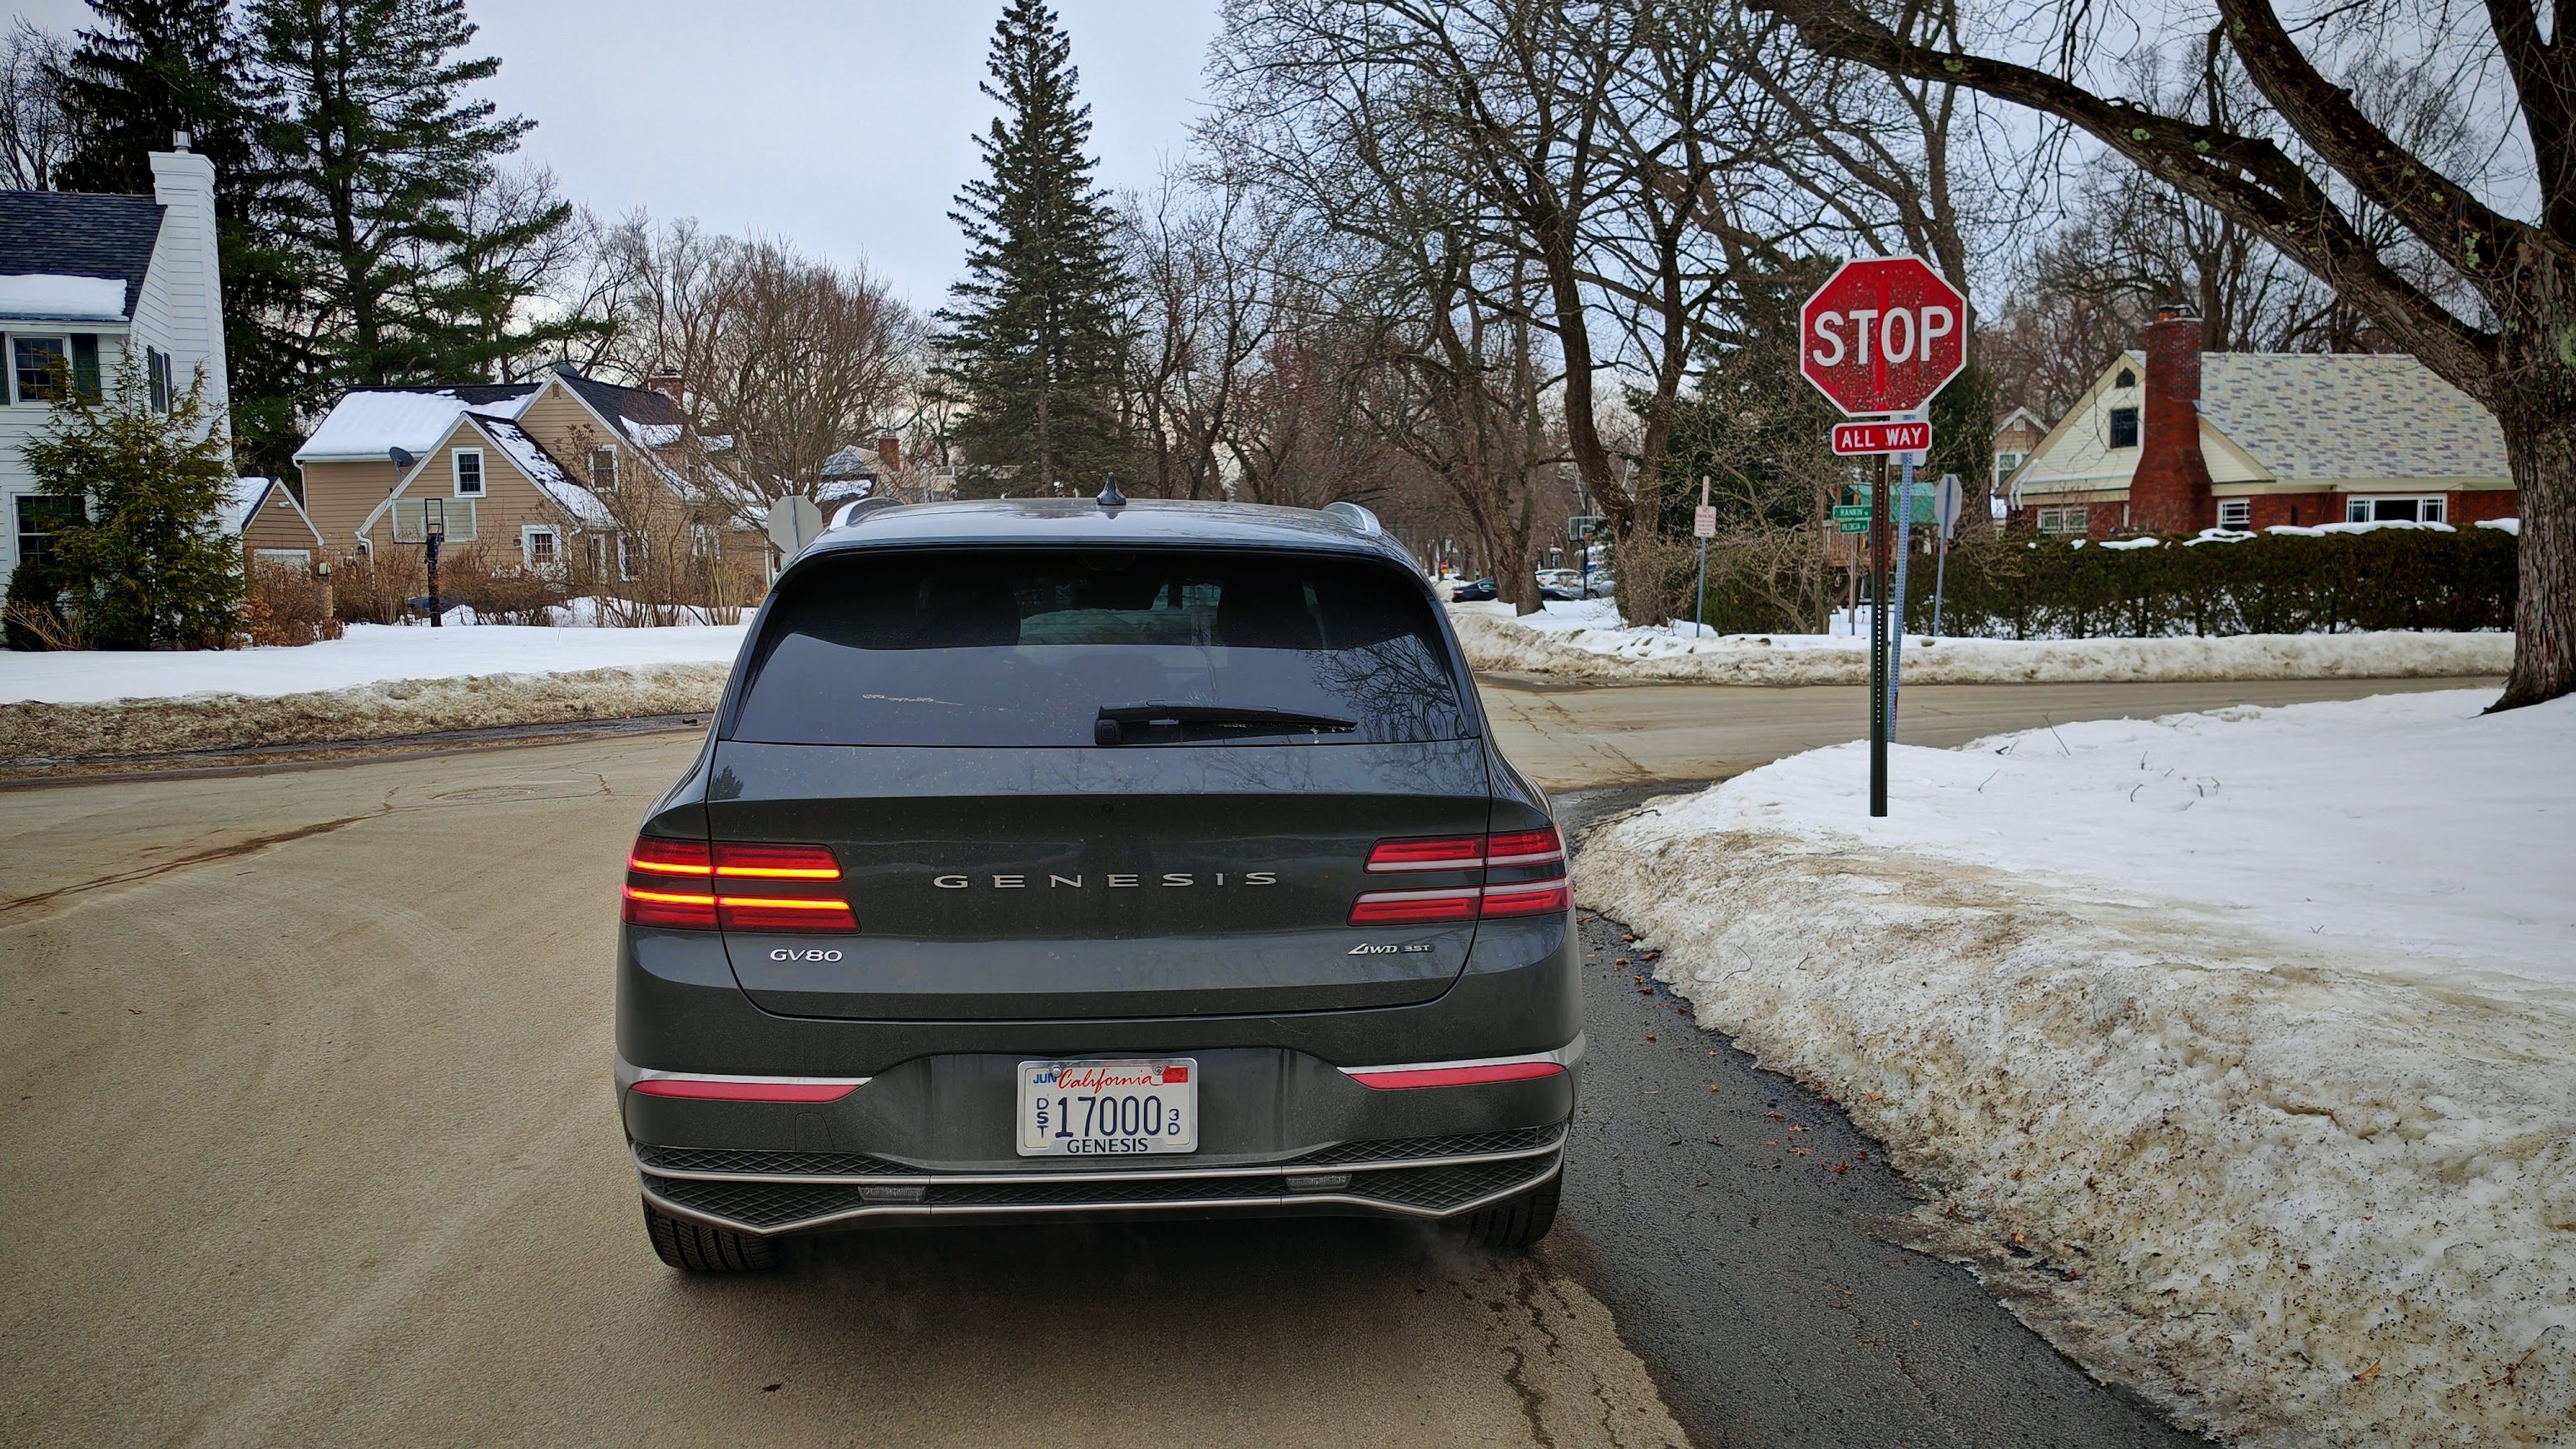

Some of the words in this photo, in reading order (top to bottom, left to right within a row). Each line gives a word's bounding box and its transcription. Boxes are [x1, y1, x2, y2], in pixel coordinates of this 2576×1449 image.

[1812, 305, 1954, 367] STOP
[1840, 429, 1875, 448] ALL
[1885, 427, 1923, 447] WAY
[1840, 508, 1863, 517] RANKIN
[933, 872, 1277, 888] GENESIS
[770, 948, 843, 962] GV80
[1033, 1073, 1058, 1085] JUN
[1058, 1068, 1163, 1094] California
[1054, 1095, 1162, 1139] 17000
[1066, 1137, 1148, 1154] GENESIS
